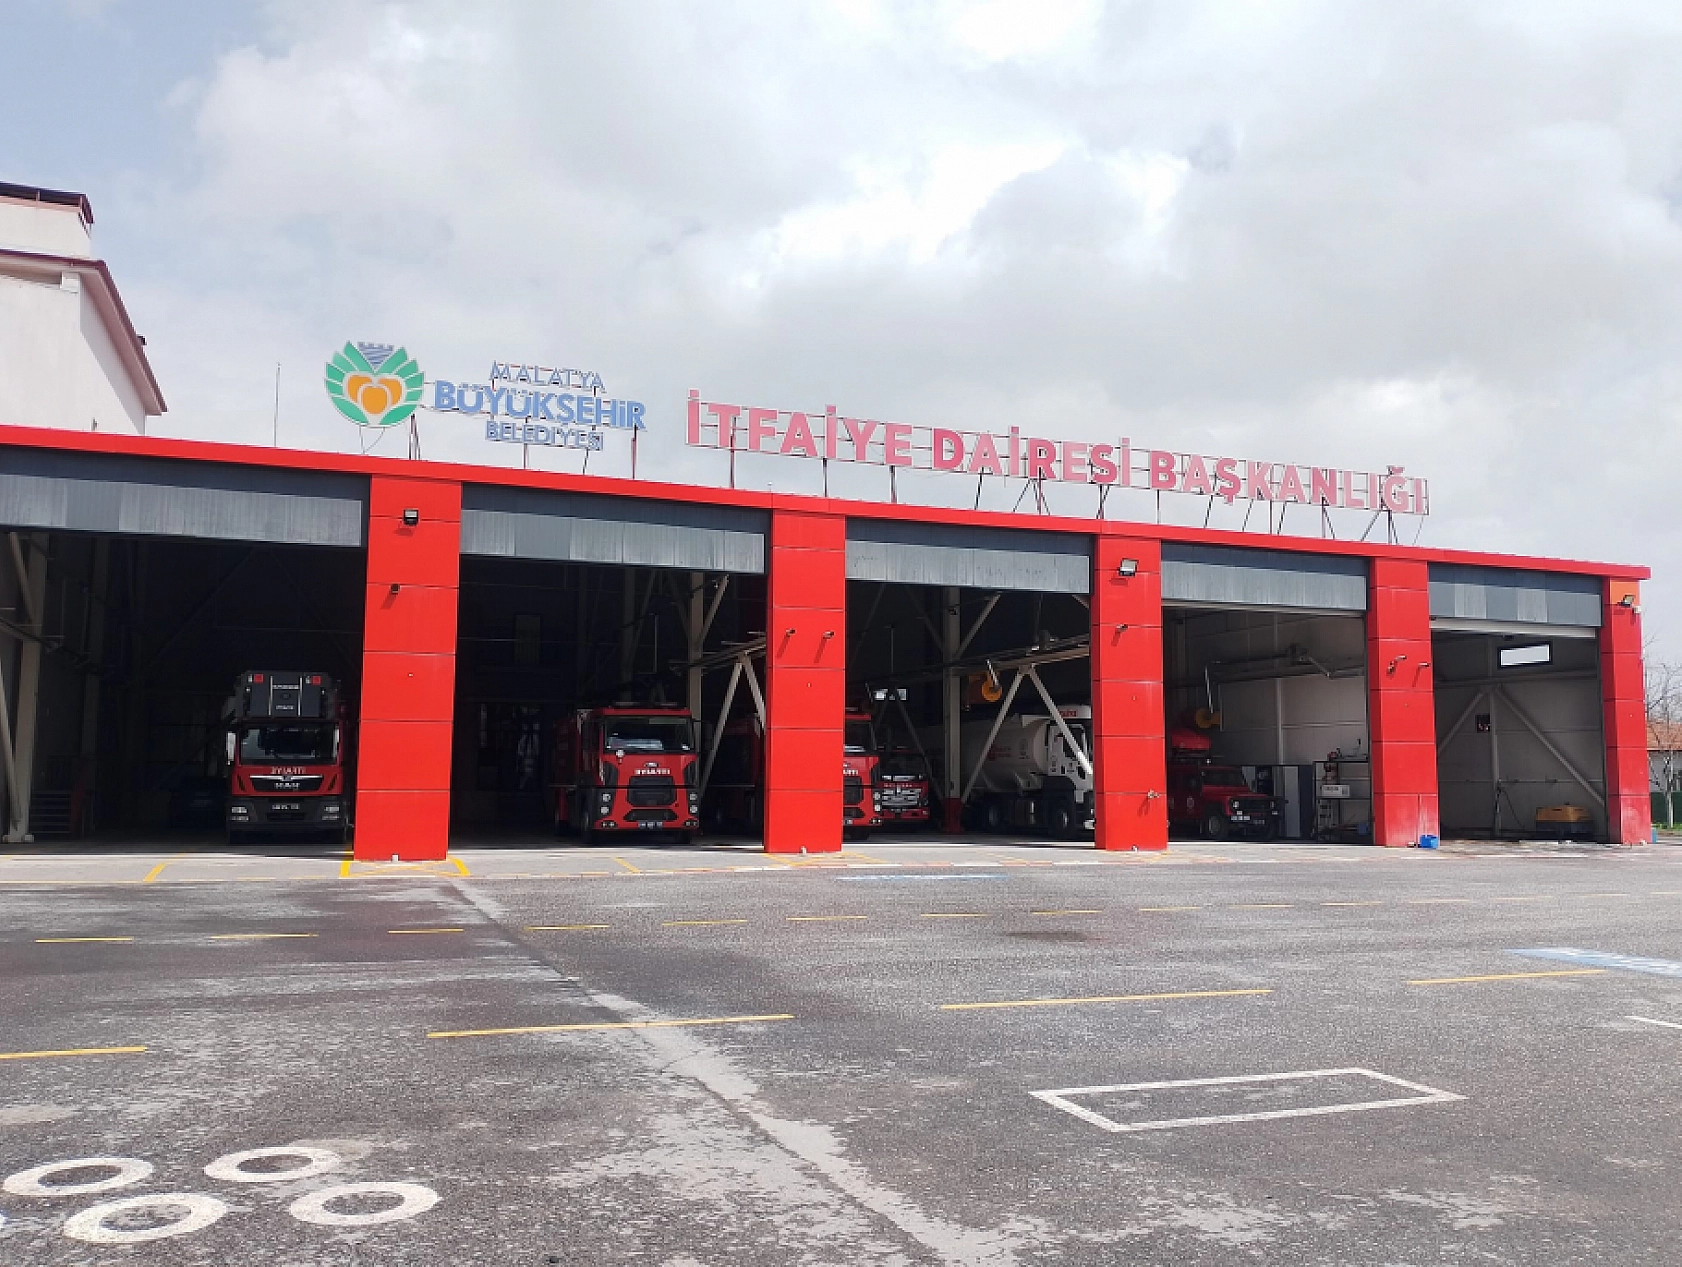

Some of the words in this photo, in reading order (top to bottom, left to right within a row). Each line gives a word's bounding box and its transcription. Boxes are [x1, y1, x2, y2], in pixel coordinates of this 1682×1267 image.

[489, 360, 606, 393] MALATYA
[687, 389, 913, 467] İTFAİYE
[931, 426, 1131, 486] DAİRESİ
[1151, 450, 1424, 514] BAŞKANLIĞI
